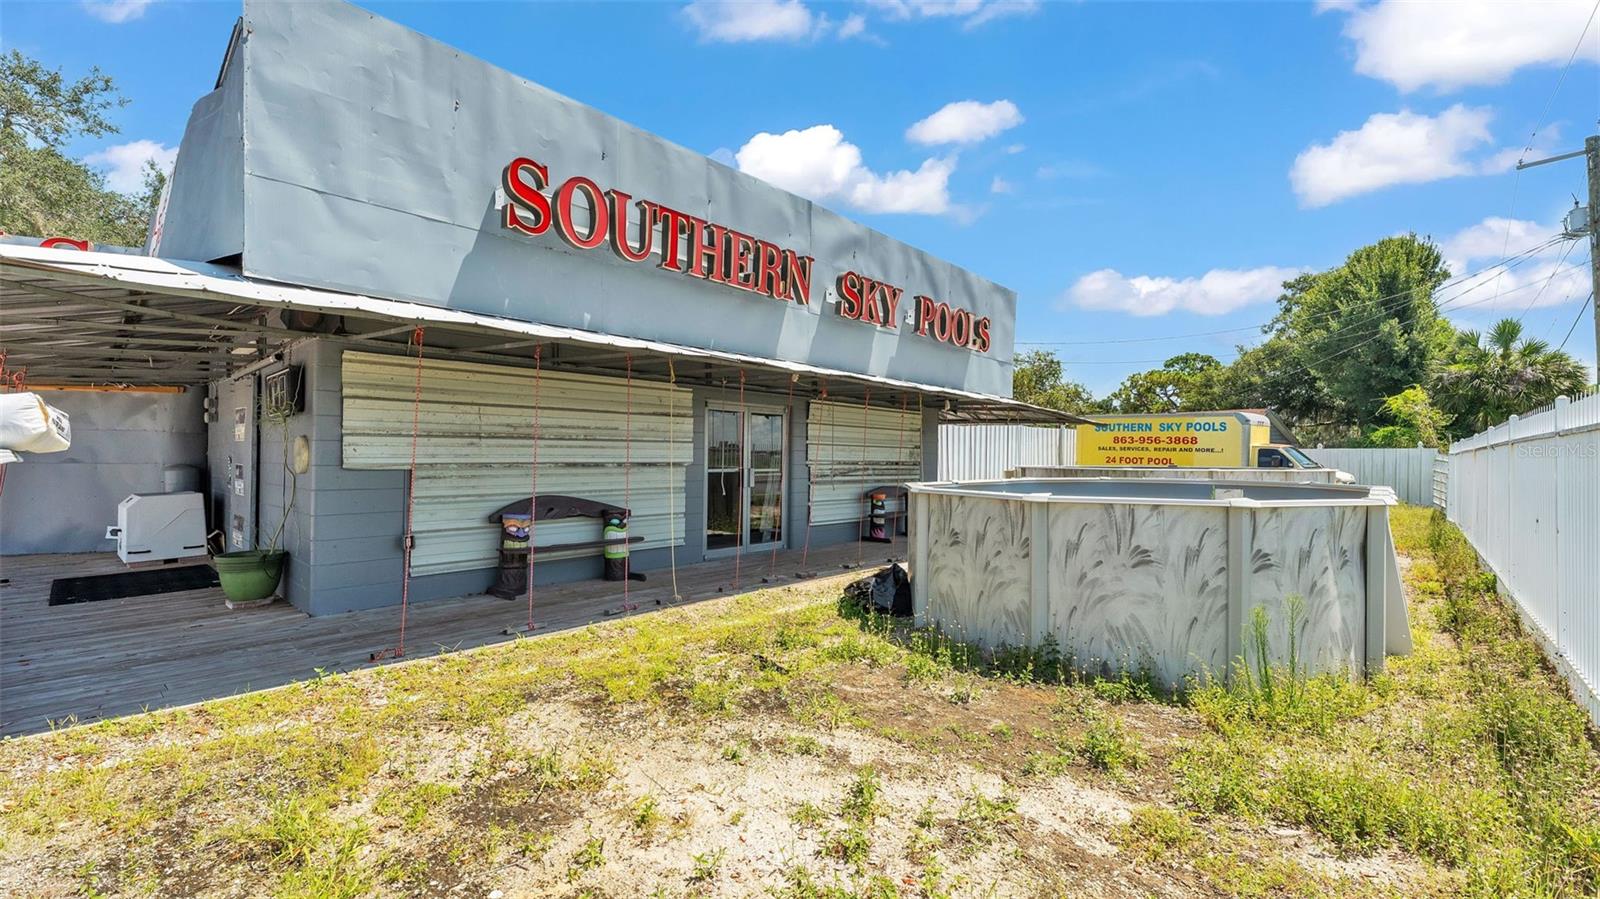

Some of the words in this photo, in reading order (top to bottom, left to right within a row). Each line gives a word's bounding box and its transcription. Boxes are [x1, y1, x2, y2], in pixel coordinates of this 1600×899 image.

[501, 156, 816, 305] SOUTHERN
[835, 270, 904, 330] SKY
[914, 294, 993, 354] POOLS
[1159, 422, 1182, 432] SKY
[1186, 421, 1227, 432] POOLS
[1112, 435, 1198, 445] 863-956-3868
[1105, 456, 1117, 464] 24
[1119, 456, 1144, 464] FOOT
[1147, 457, 1175, 466] POOL
